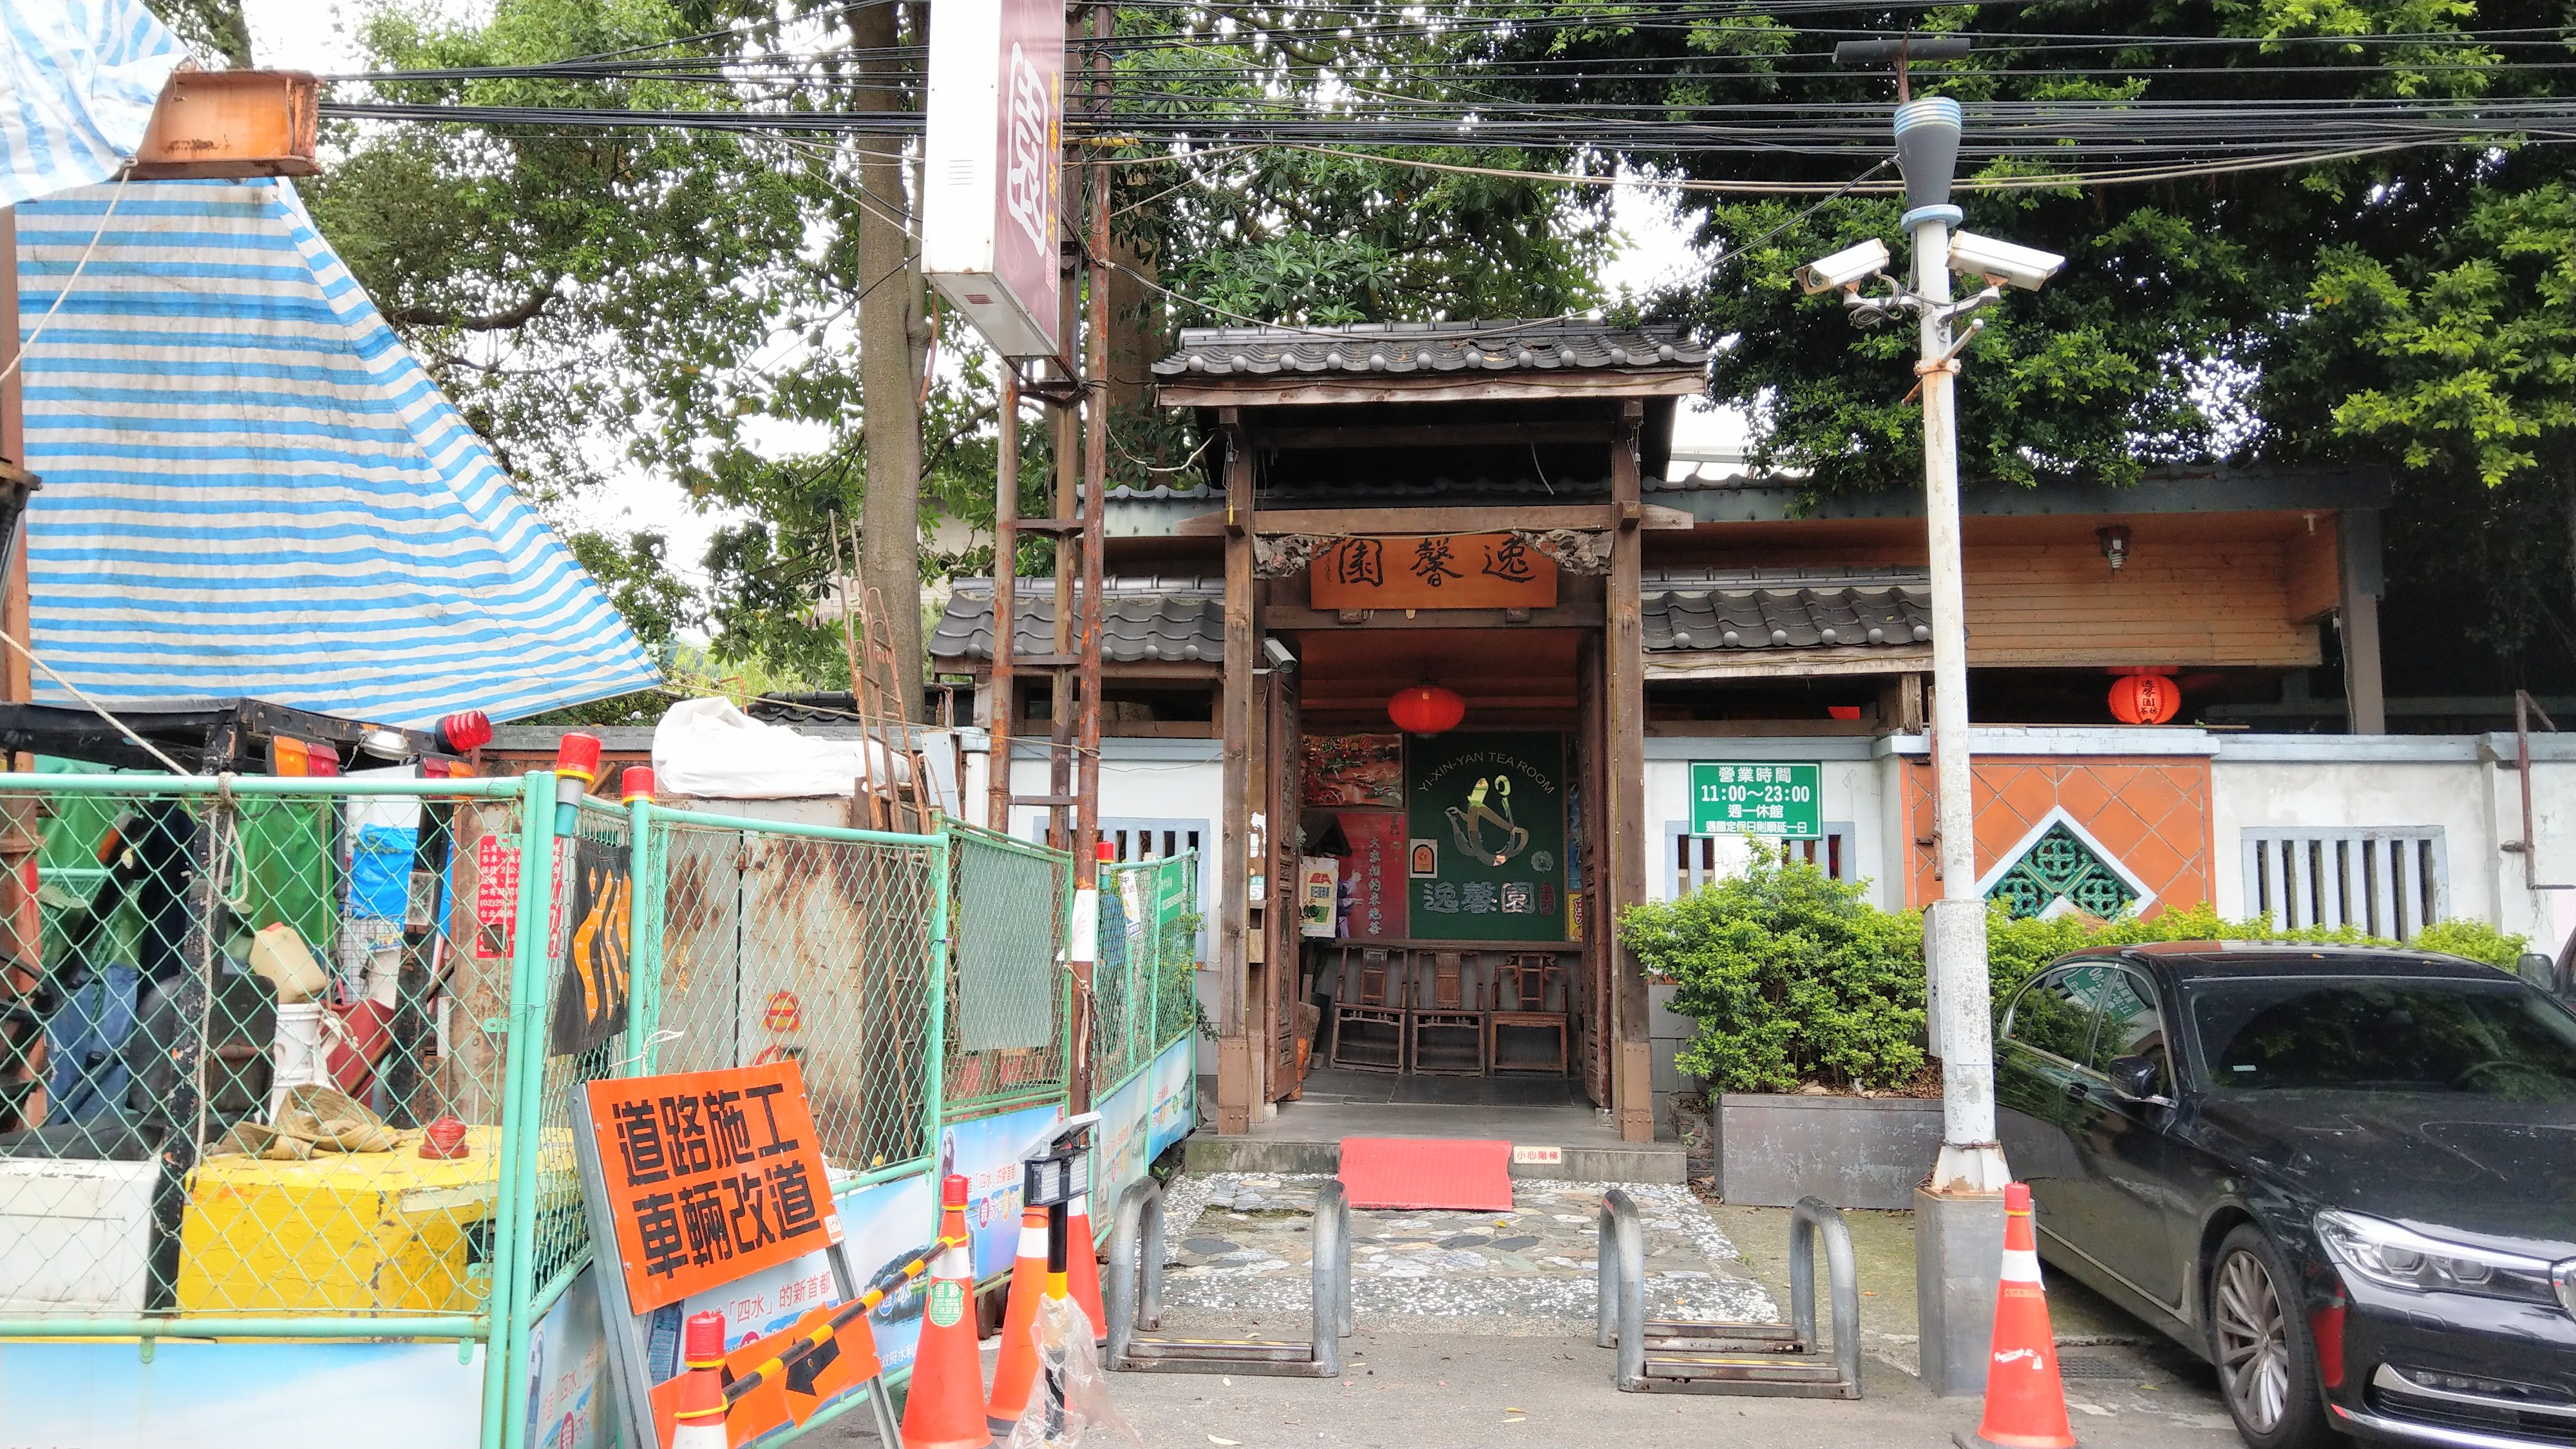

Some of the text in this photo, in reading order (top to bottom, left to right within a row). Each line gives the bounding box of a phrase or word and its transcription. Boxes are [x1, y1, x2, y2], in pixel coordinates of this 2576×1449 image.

[1418, 752, 1555, 795] YI-XIN-YAN TEA ROOM
[1719, 766, 1792, 784] 營業時間
[1728, 804, 1784, 819] 週一休館
[612, 1083, 800, 1188] 道路施工
[1517, 1150, 1558, 1160] 小心階梯
[632, 1159, 822, 1280] 車輛改道
